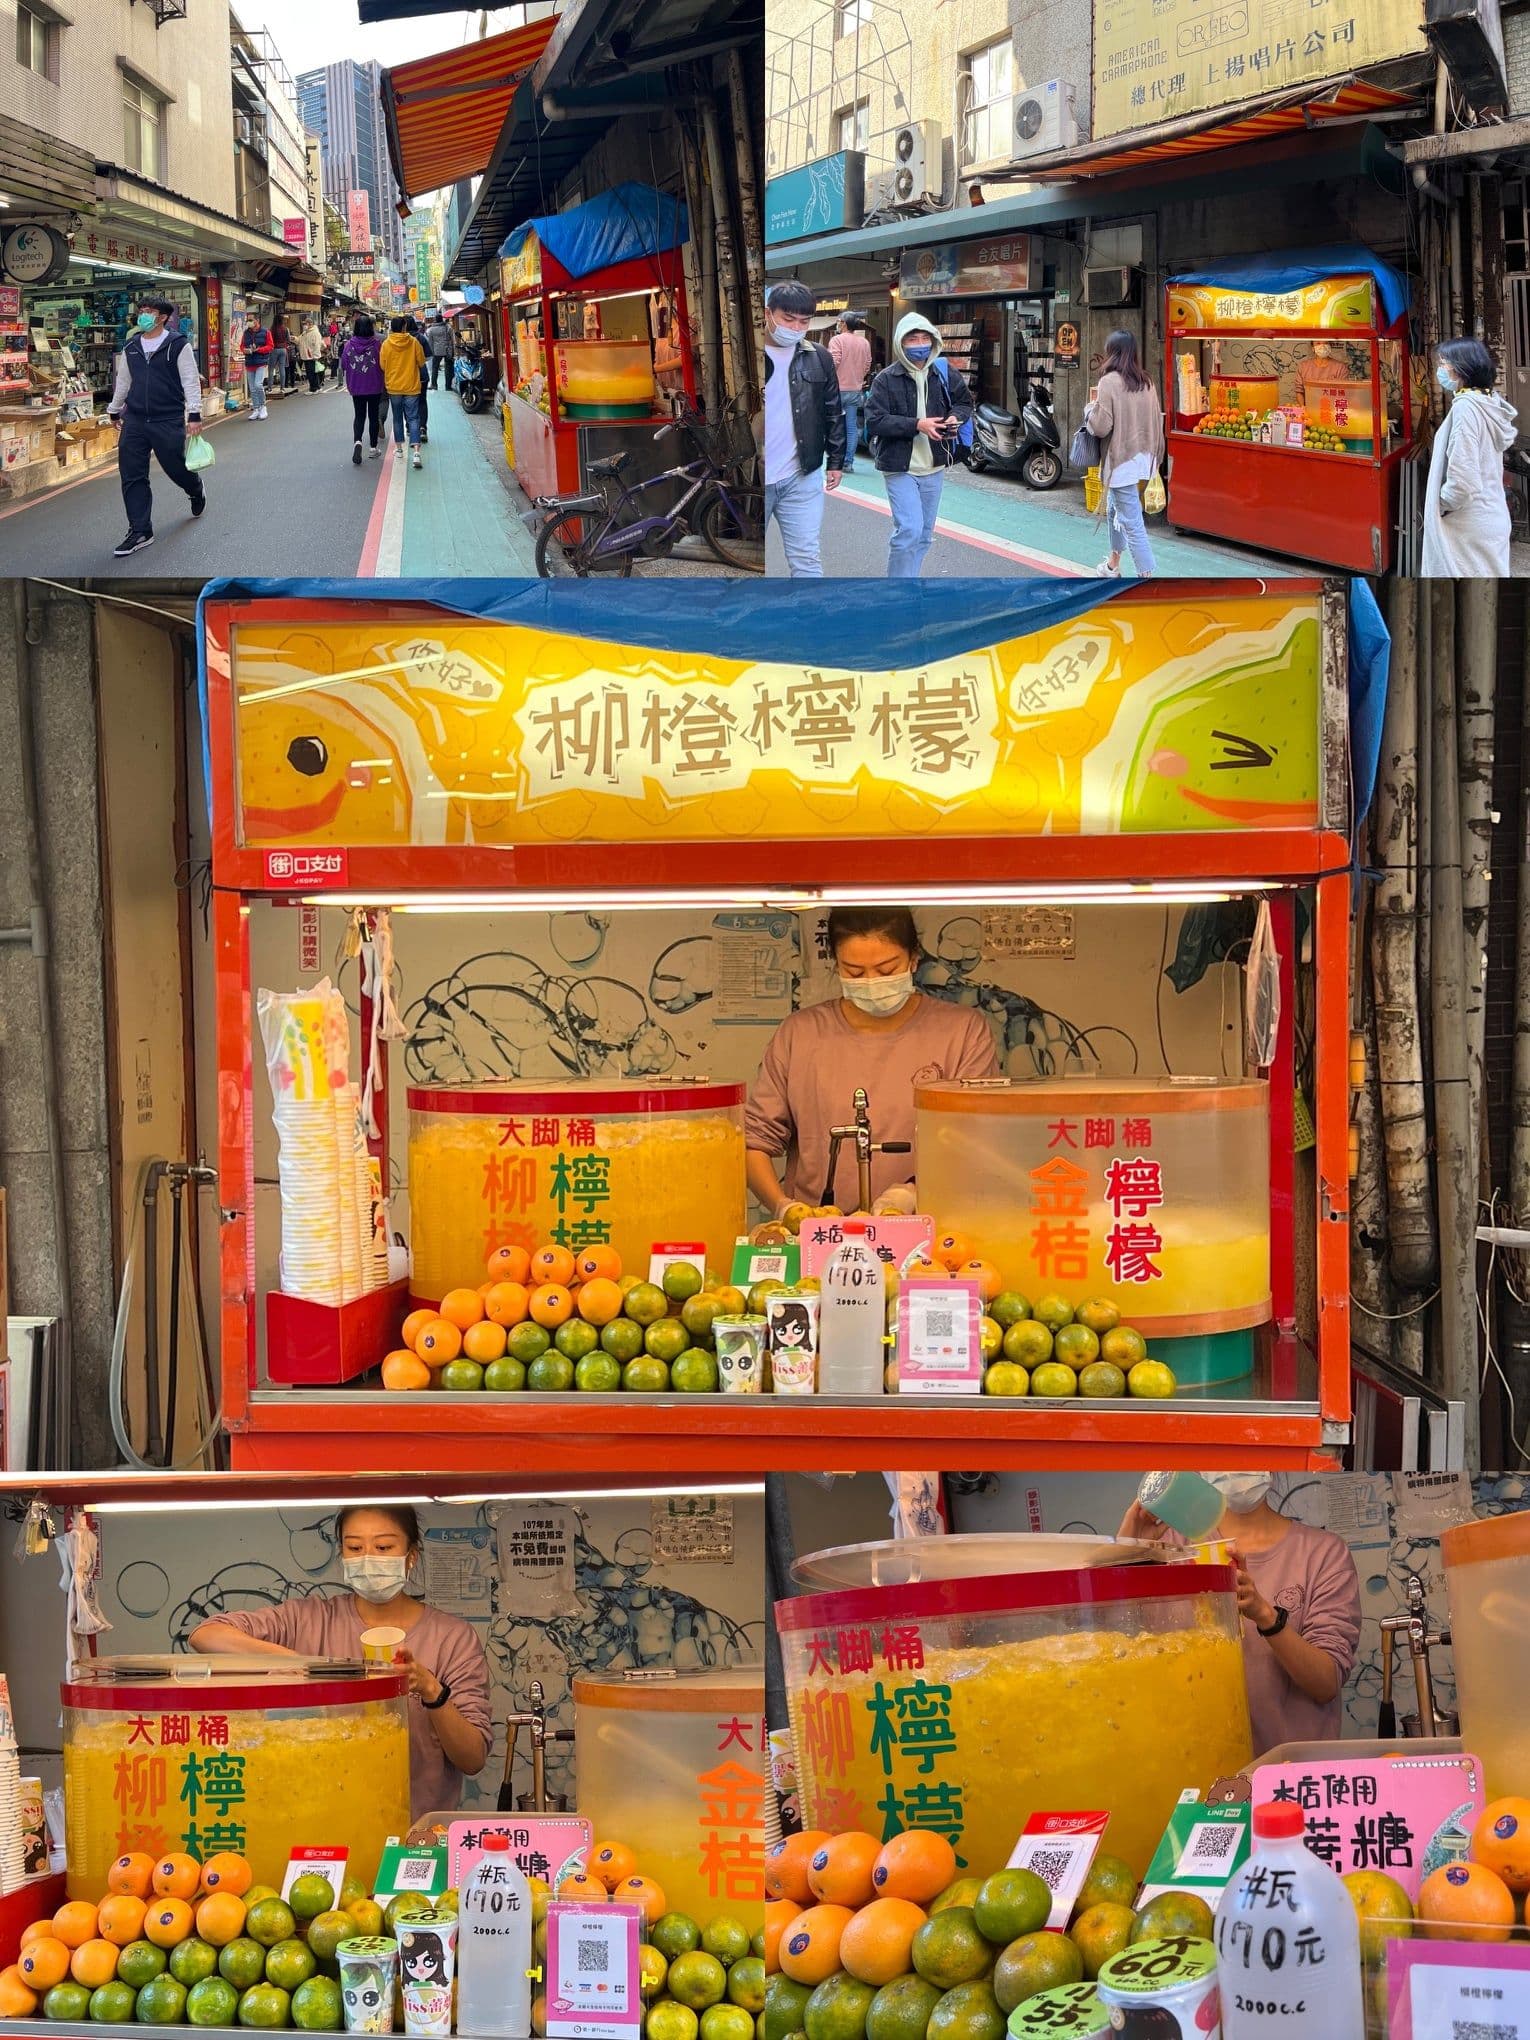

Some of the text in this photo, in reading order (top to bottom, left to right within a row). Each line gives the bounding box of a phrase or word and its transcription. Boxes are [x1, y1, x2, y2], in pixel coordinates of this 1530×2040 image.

[1108, 37, 1161, 67] AMERICAN
[1130, 18, 1357, 108] 總代理 上揚唱片公司
[11, 251, 44, 264] Logitech
[978, 242, 1023, 264] 合友唱片
[1017, 653, 1081, 713] 你好
[529, 671, 980, 785] 柳橙檸檬
[269, 852, 343, 878] 街口支付
[1029, 1156, 1090, 1280] 金桔
[1104, 1156, 1165, 1284] 檸檬
[811, 1224, 876, 1245] 本店用
[828, 1265, 877, 1288] 170元
[697, 1760, 766, 1901] 金桔
[465, 1888, 521, 1913] 170元
[1150, 1936, 1201, 1956] 大
[1218, 1916, 1326, 1972] 170元
